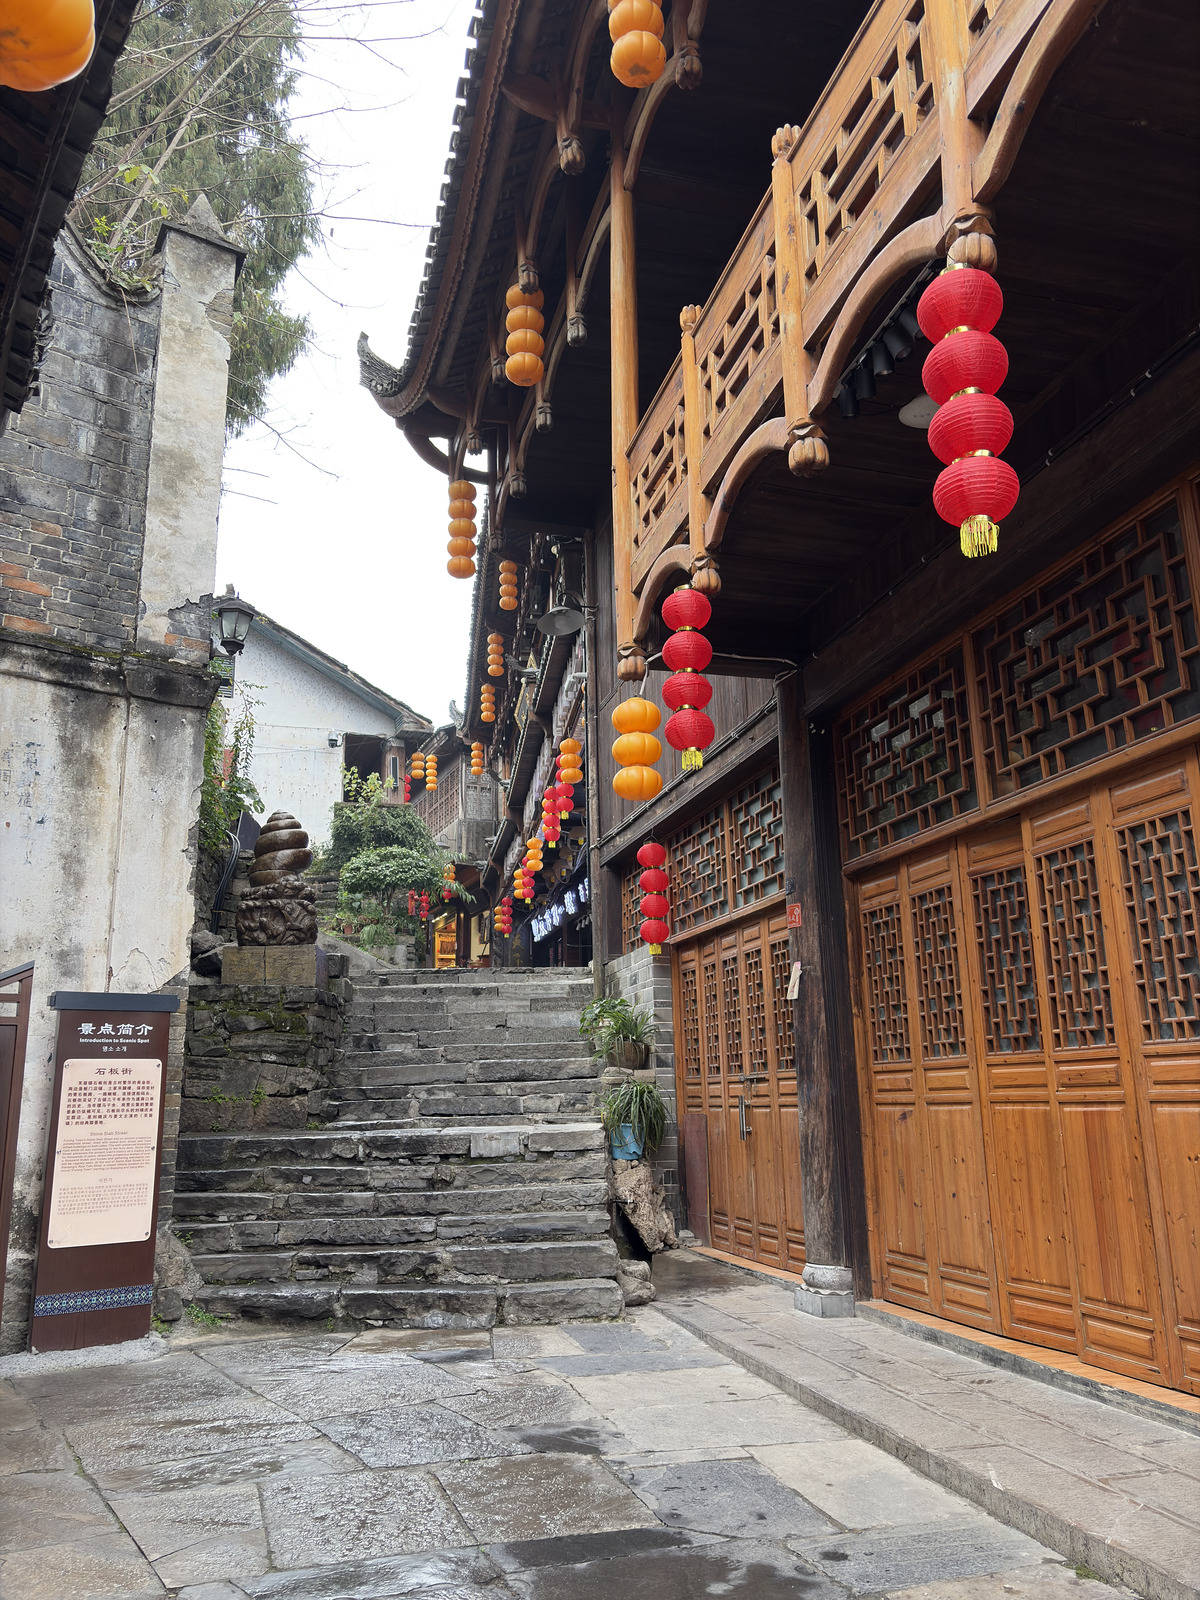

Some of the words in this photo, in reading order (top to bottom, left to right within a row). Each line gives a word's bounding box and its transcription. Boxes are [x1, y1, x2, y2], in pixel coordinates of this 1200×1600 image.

[77, 1022, 154, 1036] 景点简介
[94, 1067, 133, 1076] 石板街
